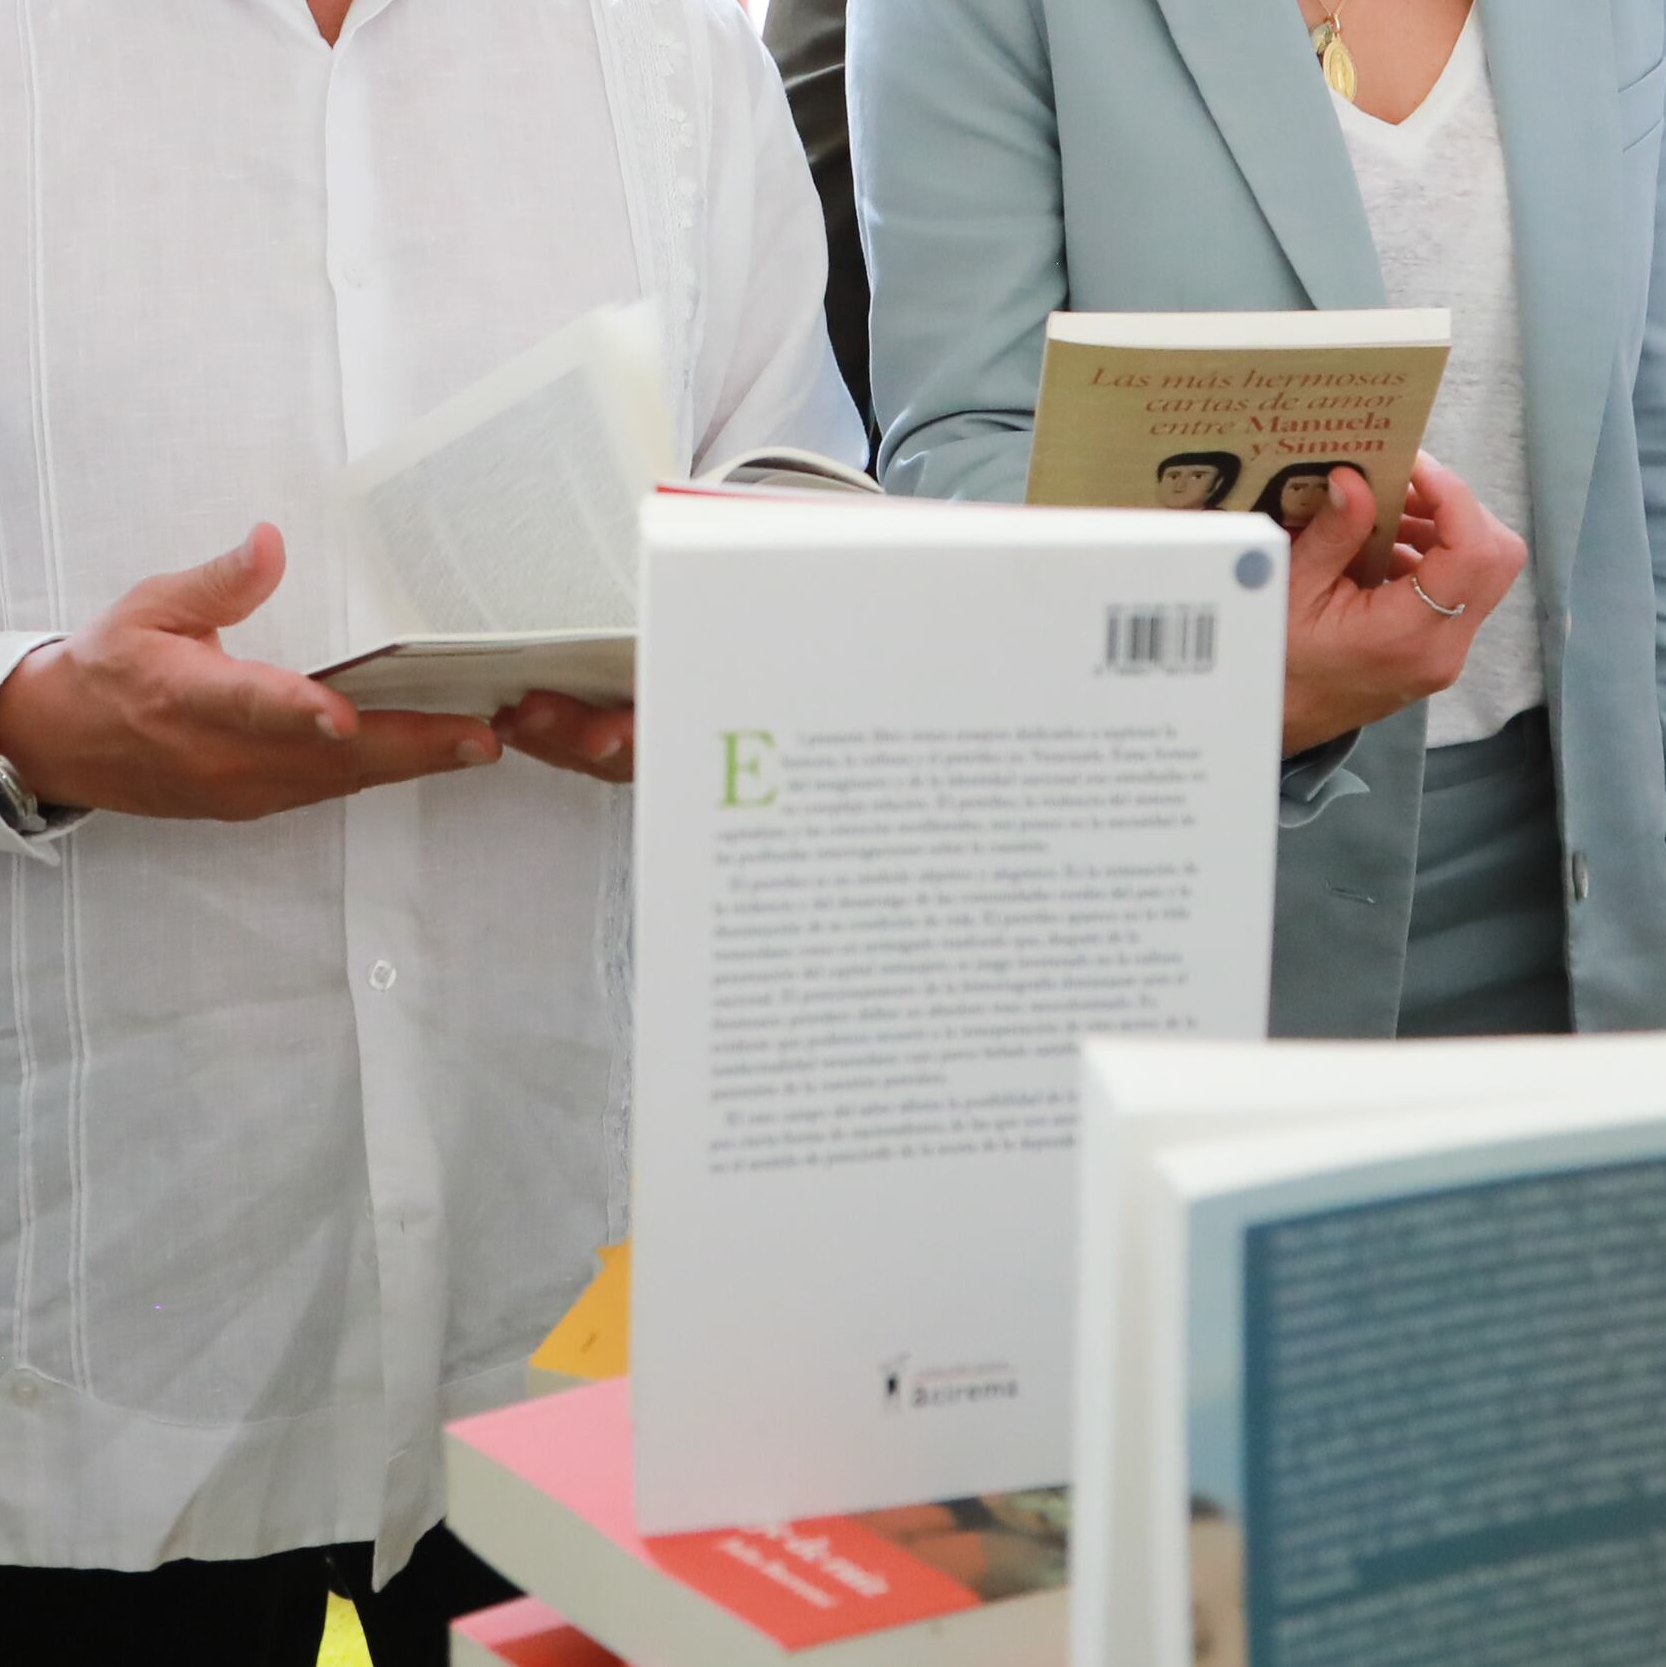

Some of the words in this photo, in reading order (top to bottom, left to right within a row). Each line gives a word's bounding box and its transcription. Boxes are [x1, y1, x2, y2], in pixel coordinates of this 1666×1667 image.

[1090, 368, 1152, 388] Las
[1158, 369, 1234, 389] más
[1243, 368, 1408, 389] hermosas
[1144, 393, 1250, 413] cartas
[1257, 391, 1303, 412] de
[1307, 393, 1404, 411] amor
[1148, 418, 1239, 436] entre
[1245, 412, 1391, 434] Manuela
[1250, 443, 1271, 462] y
